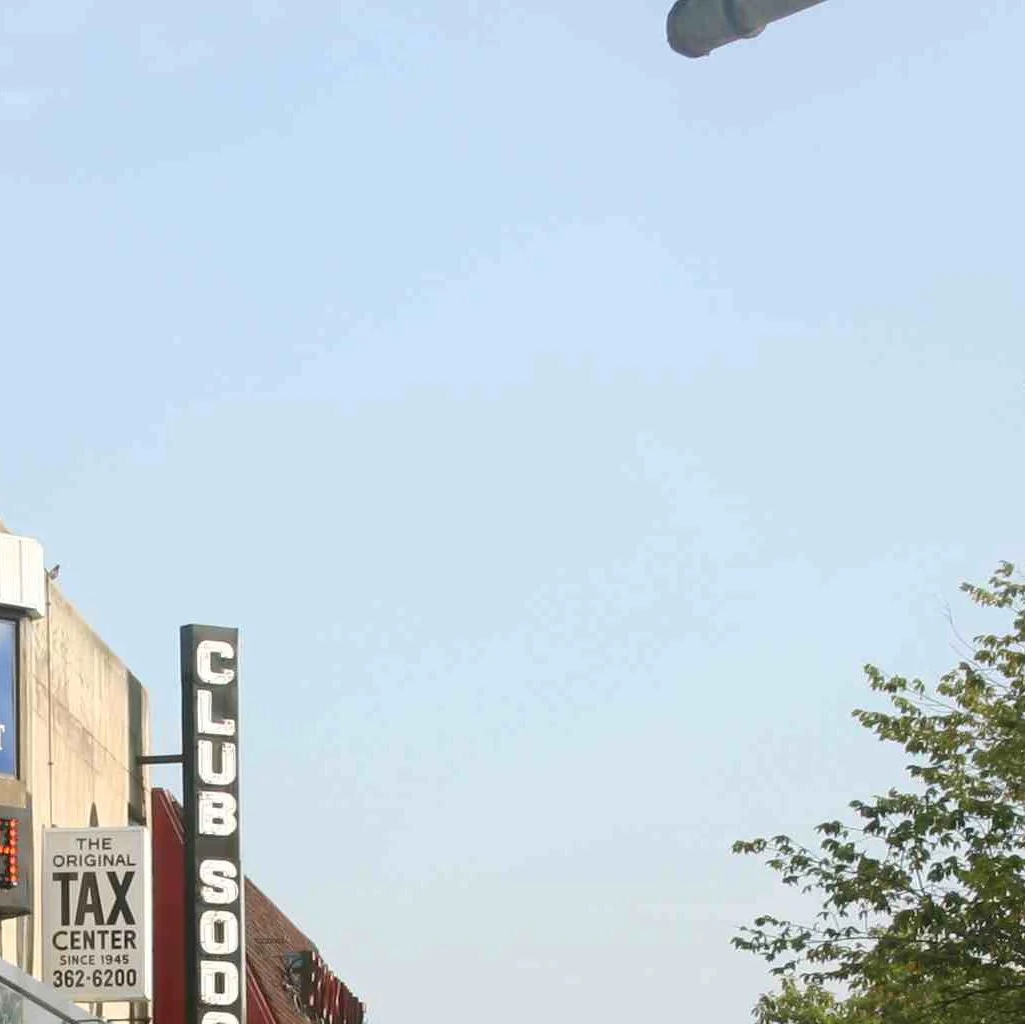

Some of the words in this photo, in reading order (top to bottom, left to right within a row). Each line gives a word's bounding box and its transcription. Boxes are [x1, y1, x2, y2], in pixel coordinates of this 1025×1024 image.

[196, 639, 237, 837] CLUB
[77, 838, 112, 850] THE
[52, 854, 136, 868] ORIGINAL
[52, 872, 136, 927] TAX
[52, 930, 137, 950] CENTER
[59, 954, 95, 966] SINCE
[101, 954, 129, 966] 1945
[52, 968, 137, 988] 362-6200
